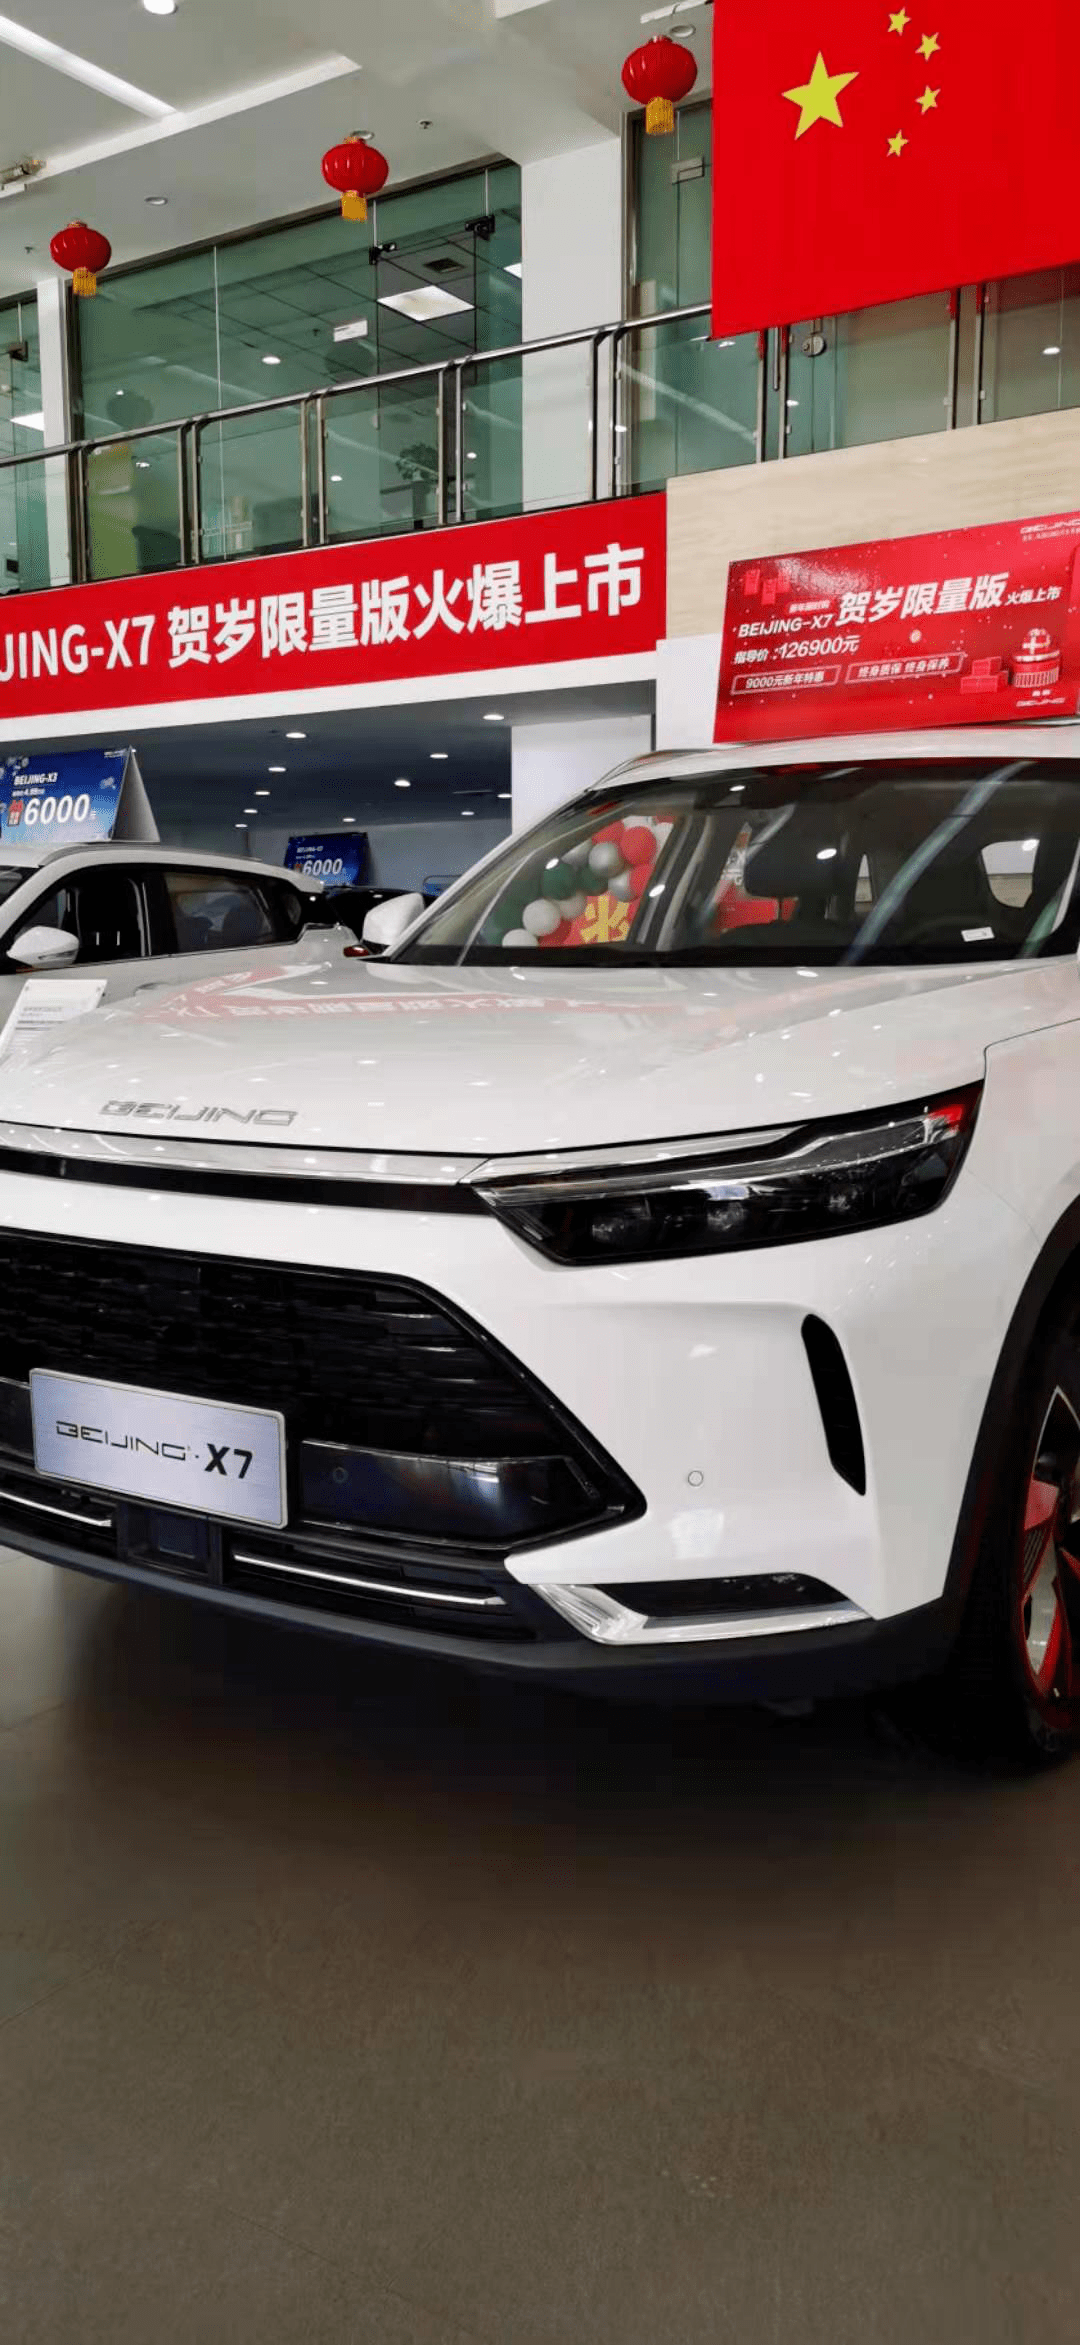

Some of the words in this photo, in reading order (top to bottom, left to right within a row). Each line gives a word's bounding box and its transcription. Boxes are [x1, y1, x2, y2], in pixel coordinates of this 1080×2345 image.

[167, 542, 645, 668] 贺岁限量版火爆上市
[738, 614, 833, 637] BEIJING-X7
[834, 572, 1009, 627] 贺岁限量版
[303, 858, 342, 876] 6000
[100, 1101, 298, 1126] BEIJING
